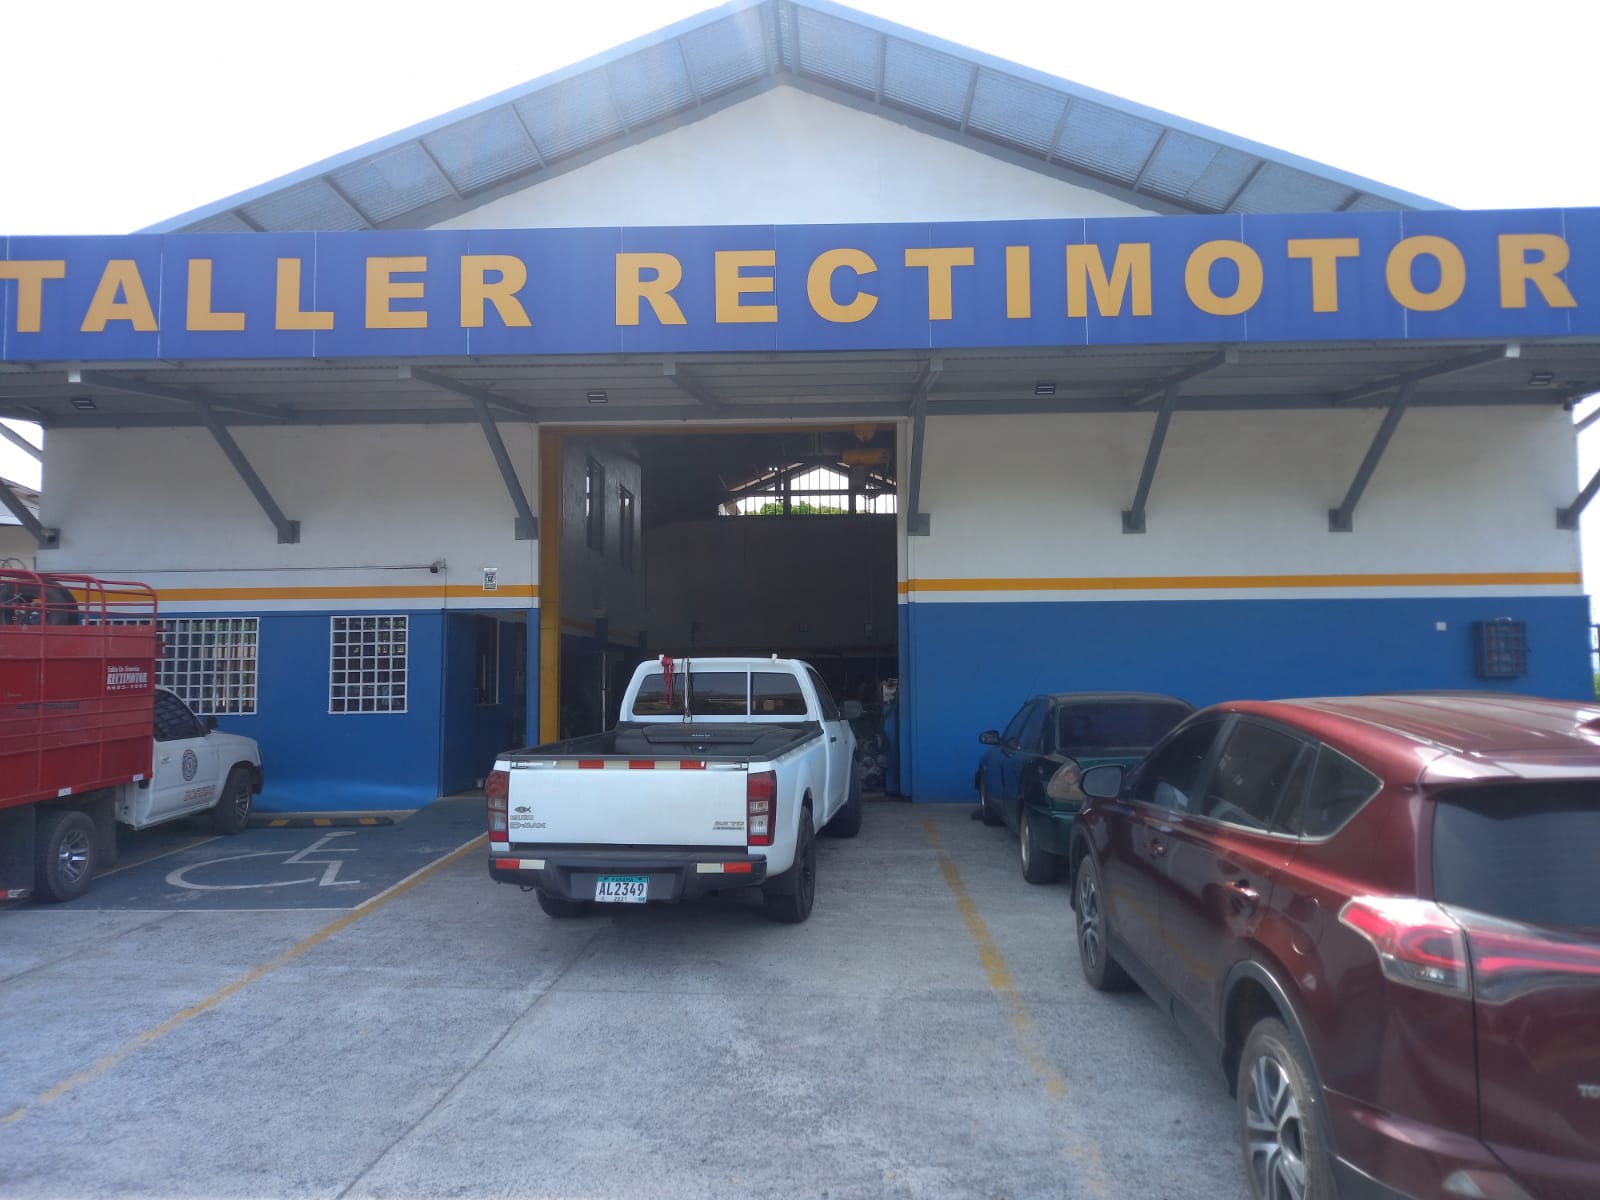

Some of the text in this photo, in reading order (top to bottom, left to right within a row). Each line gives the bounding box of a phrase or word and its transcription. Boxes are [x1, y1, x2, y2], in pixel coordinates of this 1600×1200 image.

[0, 233, 1578, 333] TALLER RECTIMOTOR
[598, 882, 644, 897] AL2349
